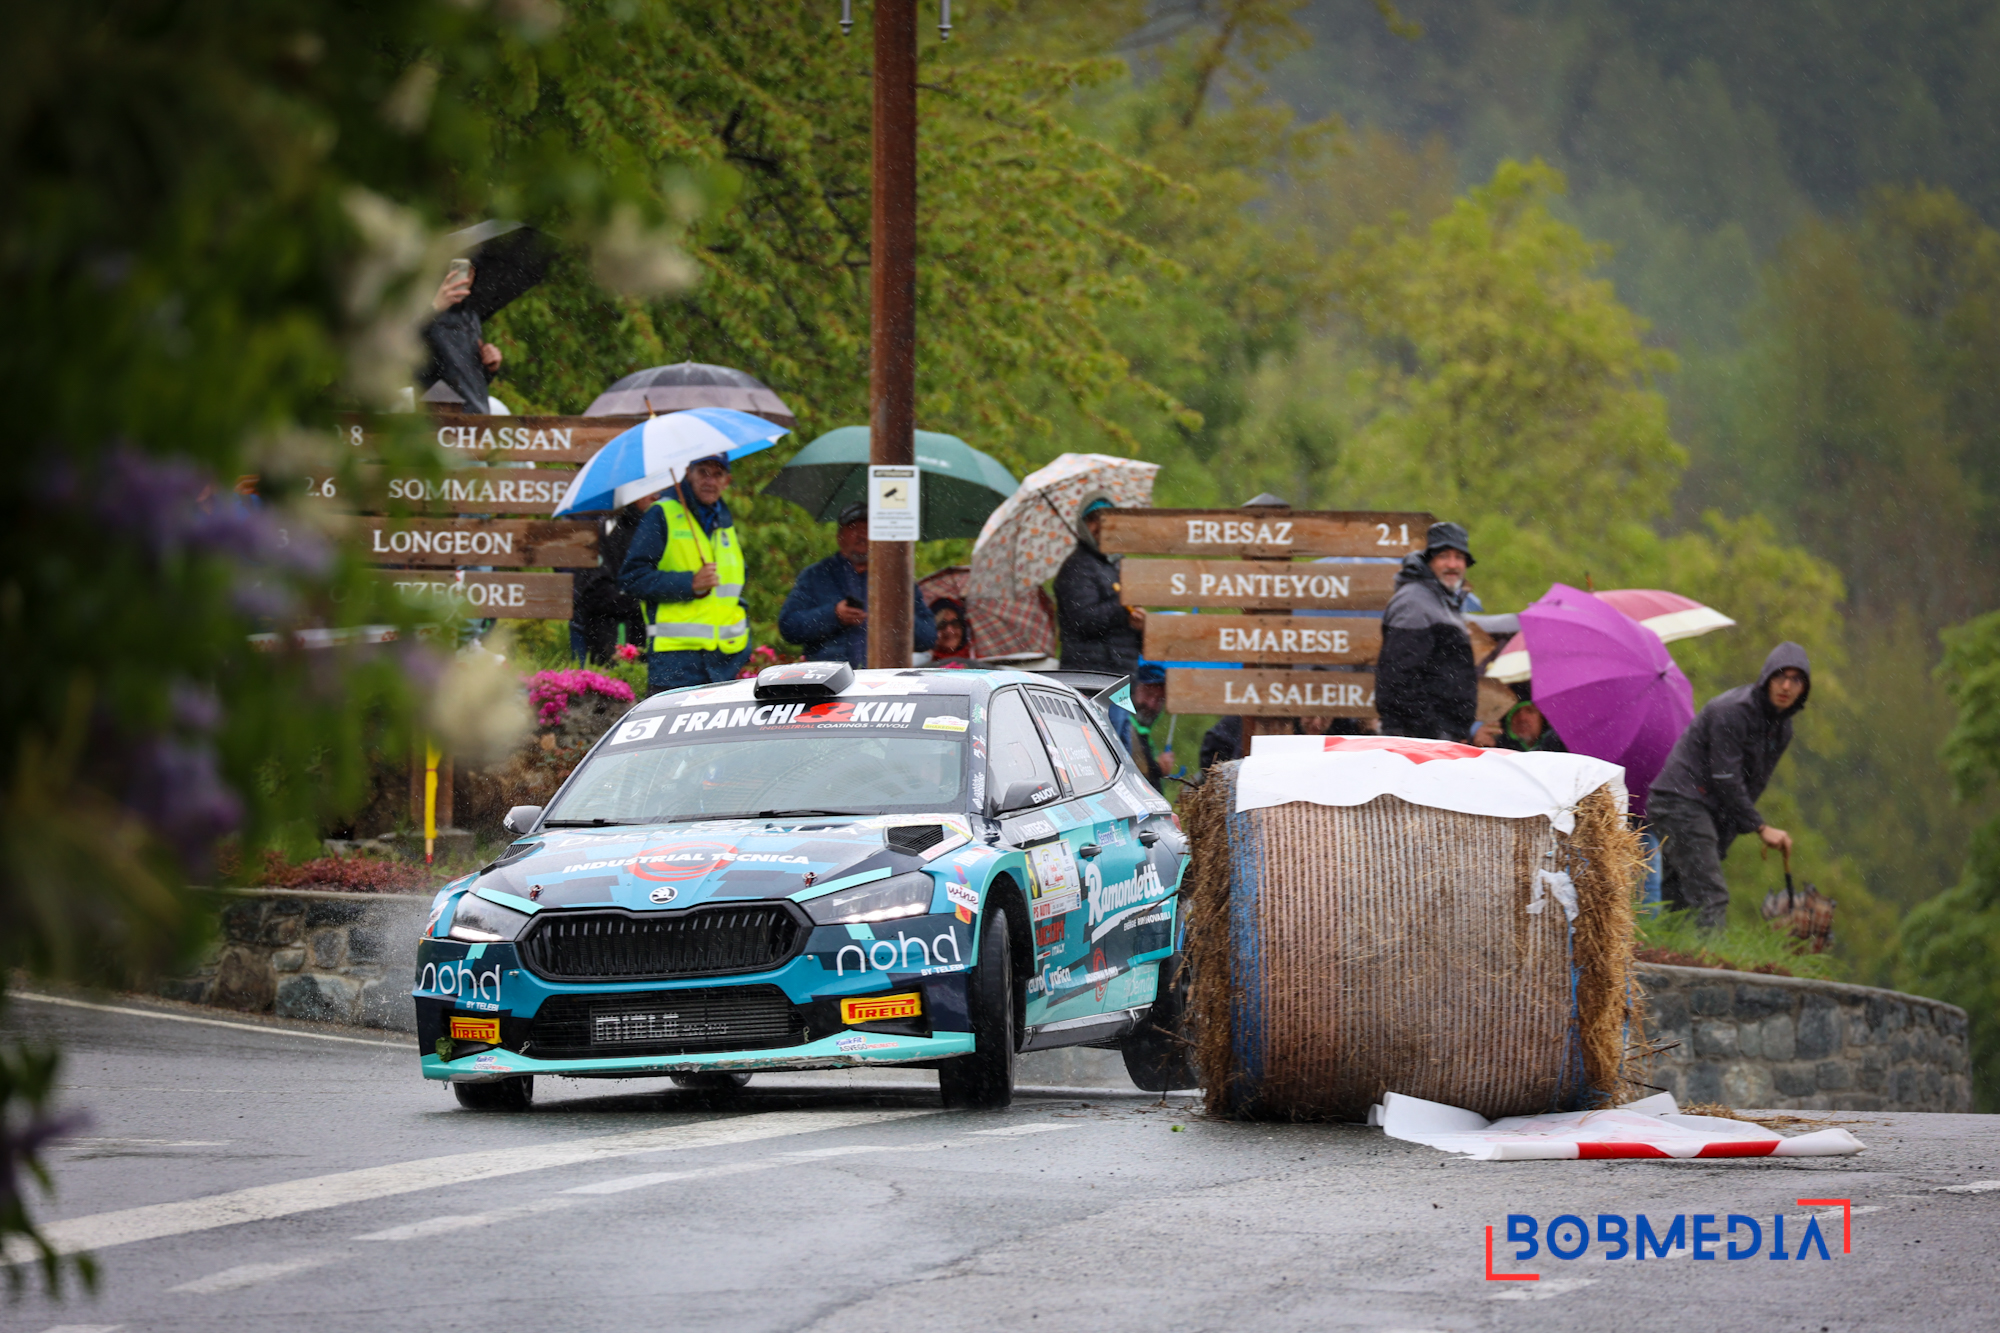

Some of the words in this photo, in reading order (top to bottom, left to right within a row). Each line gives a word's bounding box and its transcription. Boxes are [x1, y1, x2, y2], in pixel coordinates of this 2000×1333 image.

[437, 426, 573, 450] CHASSAN
[388, 479, 568, 504] SOMMARESE
[373, 530, 514, 555] LONGEON
[1186, 520, 1293, 545] ERESAZ
[1376, 523, 1410, 546] 2.1
[1170, 574, 1193, 596] S.
[1200, 574, 1350, 598] PANTEYON
[1219, 628, 1350, 653] EMARESE
[1224, 681, 1262, 704] LA
[626, 719, 653, 741] 5
[1031, 787, 1058, 804] ENJOY
[562, 853, 705, 873] INDUSTRIAL
[711, 853, 809, 865] TECNICA
[948, 886, 979, 905] wine
[1085, 863, 1164, 926] Ramondetti
[836, 926, 962, 977] nohd
[419, 960, 500, 1002] nohd
[921, 968, 932, 976] BY
[466, 1000, 475, 1008] BY
[848, 998, 916, 1019] PIRELLI
[452, 1022, 496, 1039] PIRELLI
